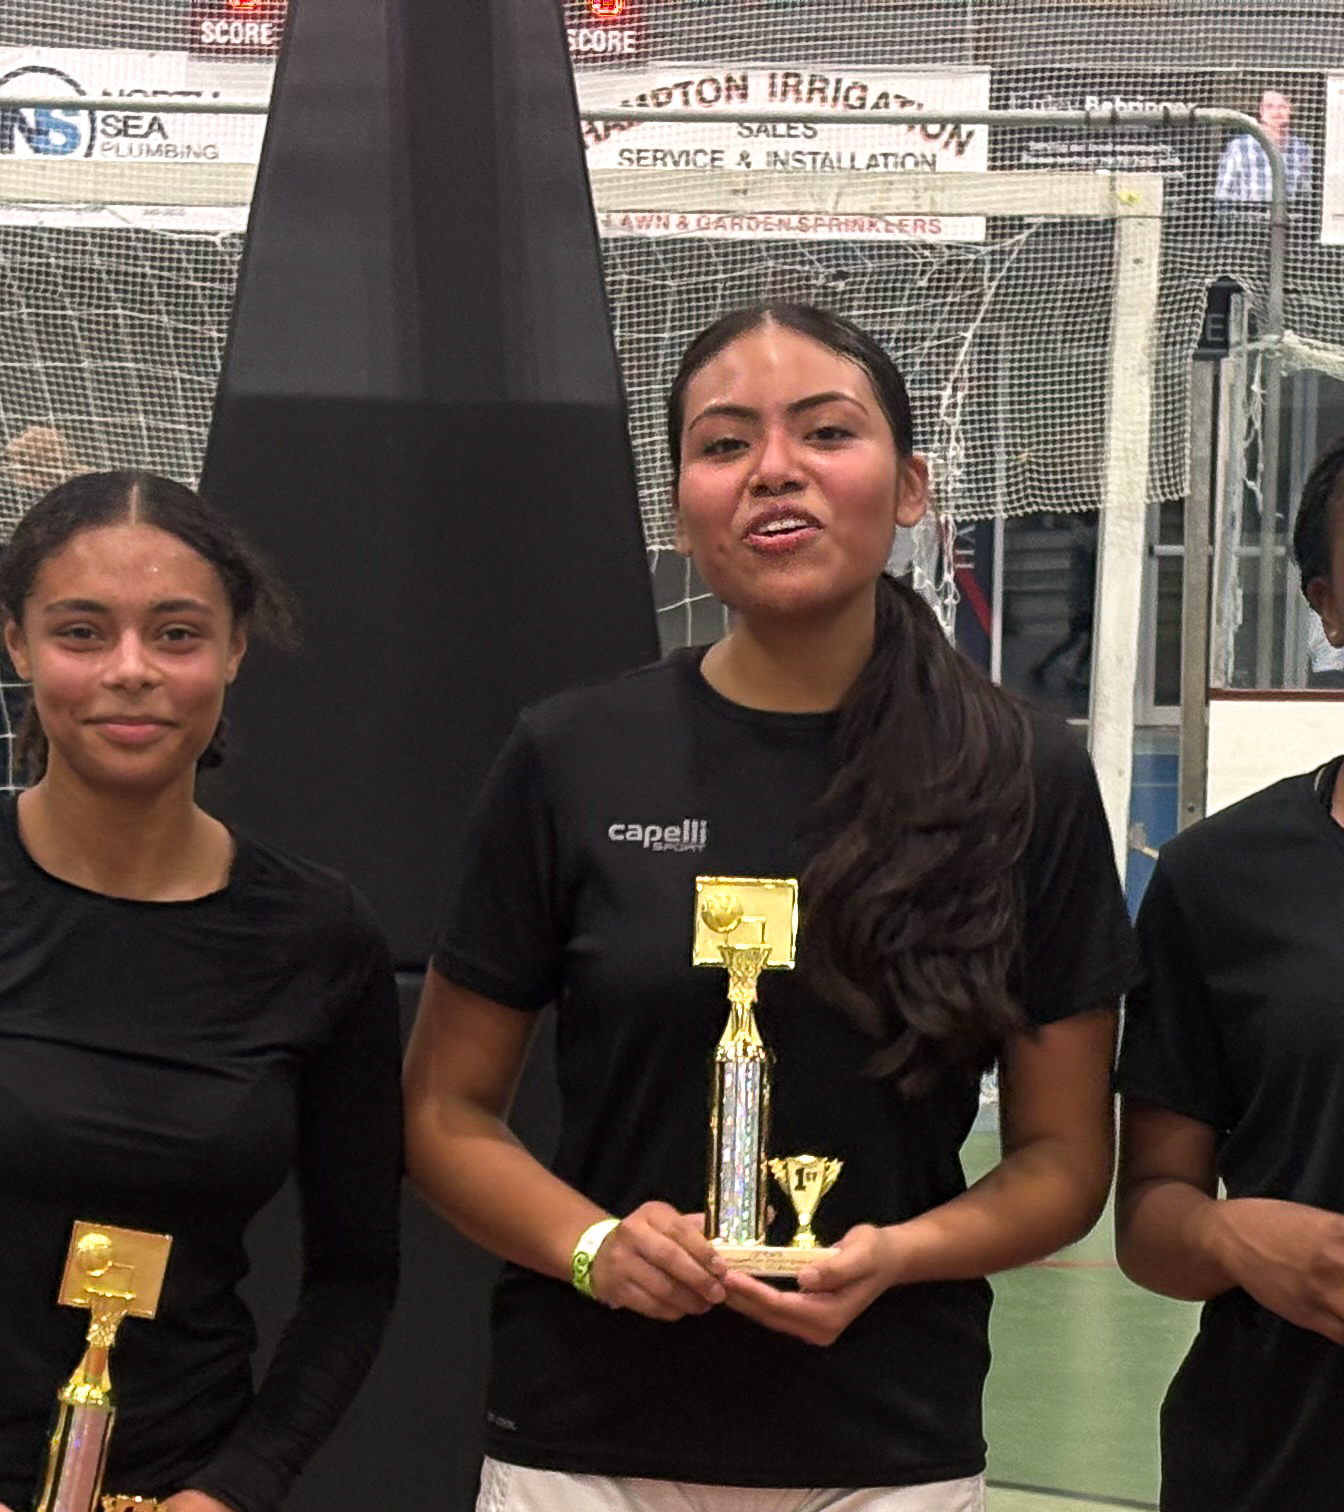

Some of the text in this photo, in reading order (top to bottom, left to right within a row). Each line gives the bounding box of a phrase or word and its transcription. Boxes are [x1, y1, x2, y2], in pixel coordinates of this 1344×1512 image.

[201, 21, 274, 45] SCORE
[99, 114, 169, 141] SEA
[736, 121, 818, 140] SALES
[100, 141, 220, 161] PLUMBING
[617, 148, 938, 172] SERVICE & INSTALLATION
[674, 216, 692, 232] &
[797, 217, 943, 236] SPRINKLERS
[607, 818, 707, 849] capelli
